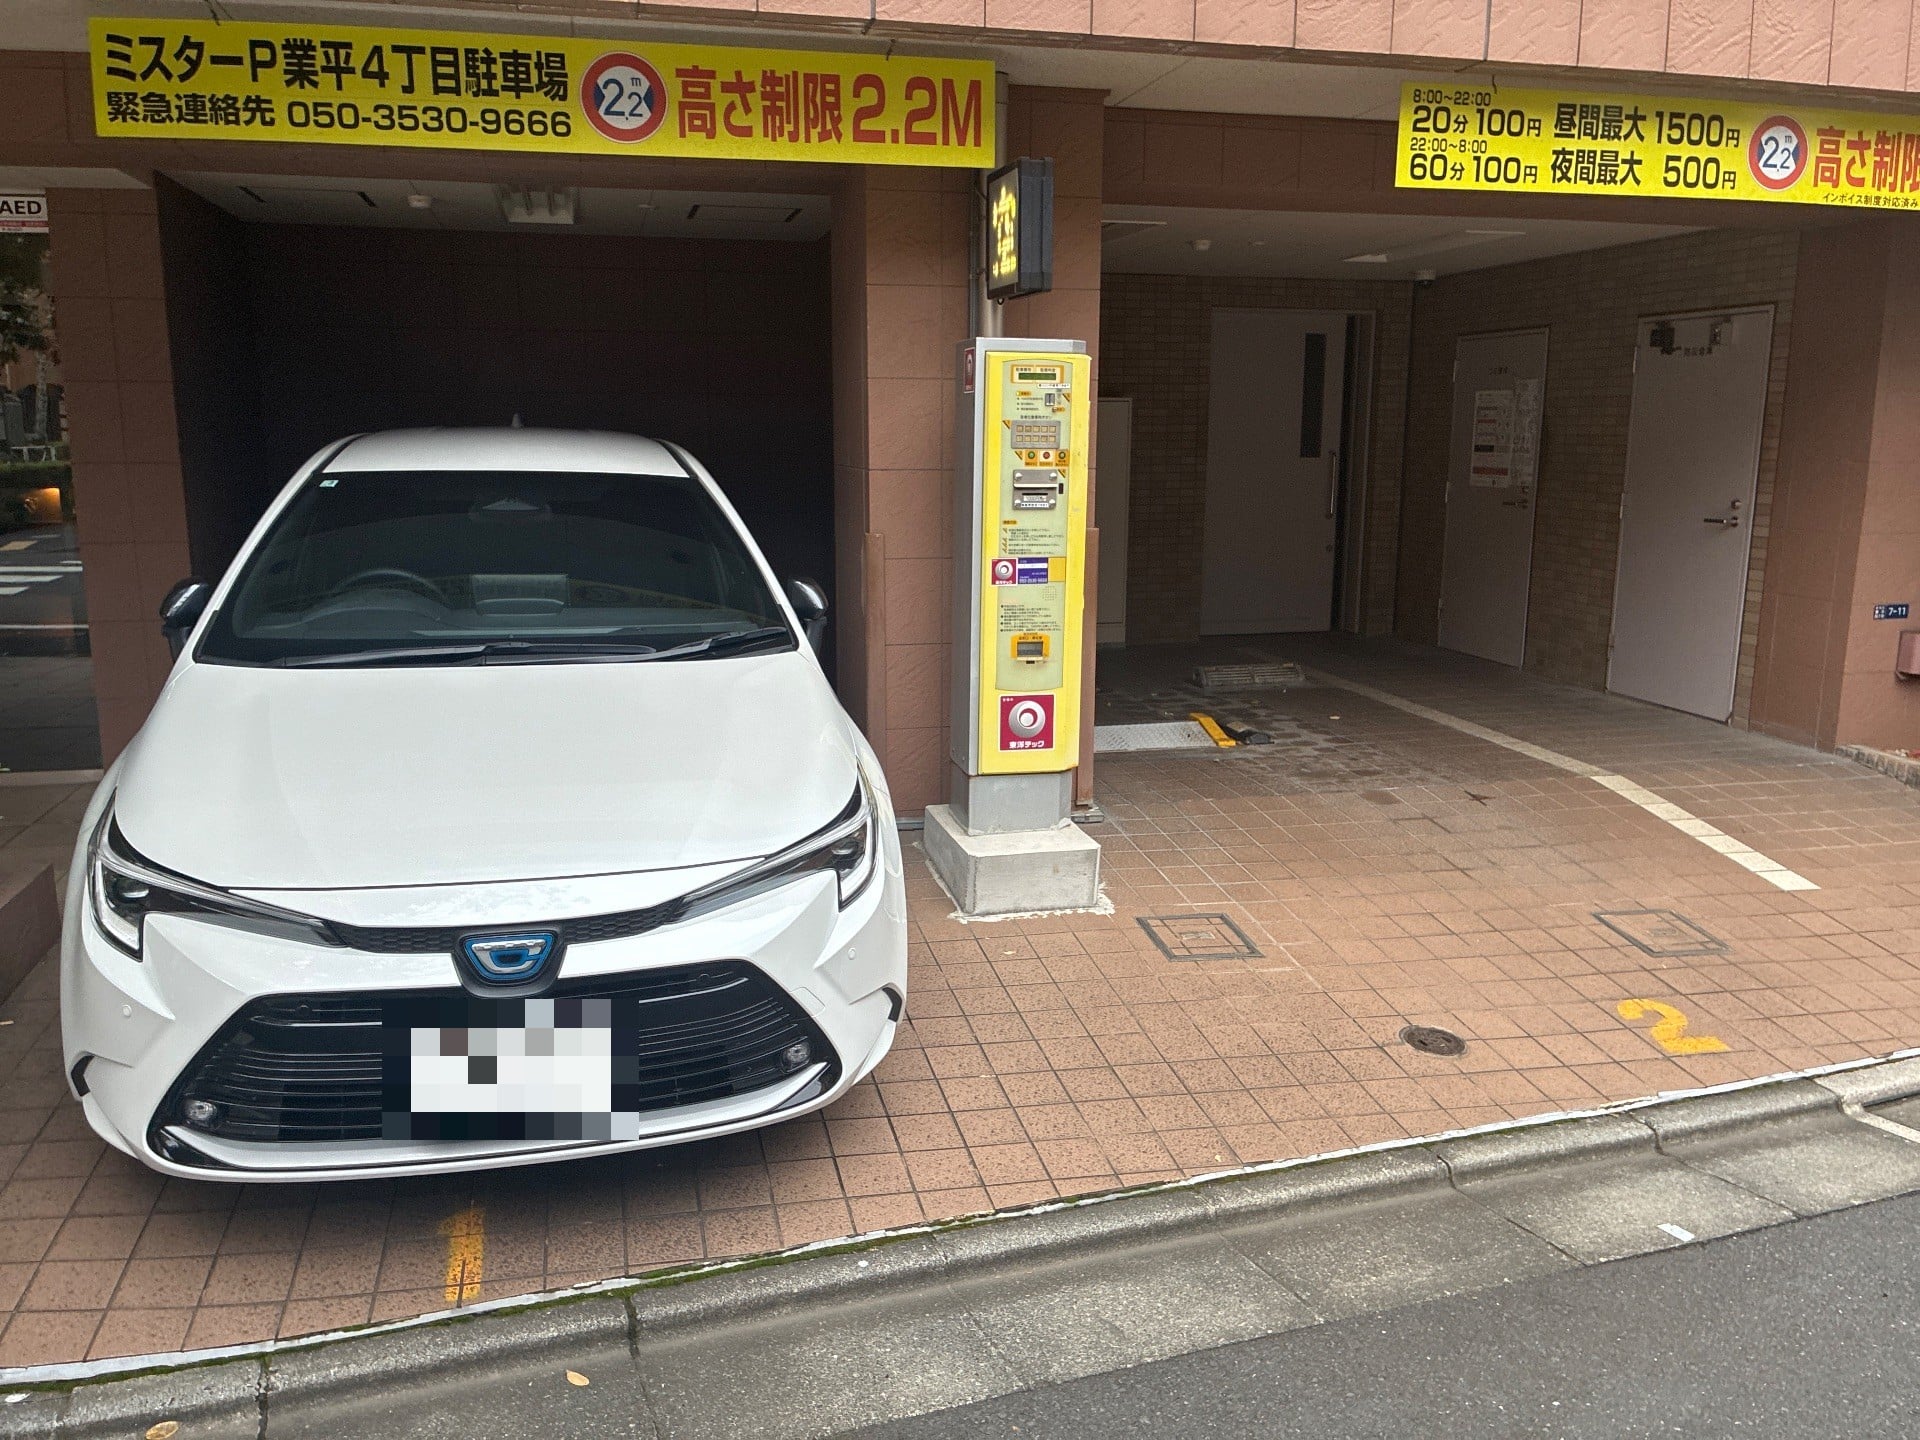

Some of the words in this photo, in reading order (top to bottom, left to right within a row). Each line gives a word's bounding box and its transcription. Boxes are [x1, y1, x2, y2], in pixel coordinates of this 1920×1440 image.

[106, 33, 568, 102] ミスターP業平4丁目駐車場
[106, 91, 276, 127] 緊急連絡先
[287, 100, 571, 138] 050-3530-9666
[1476, 108, 1542, 137] 100円
[1554, 102, 1647, 142] 昼間最大
[1655, 111, 1741, 148] 1500円
[1473, 155, 1538, 184] 100円
[1551, 147, 1643, 186] 夜間最大
[1663, 155, 1737, 189] 500円
[0, 200, 42, 215] AED
[1888, 606, 1906, 616] 7-11
[1616, 998, 1732, 1055] 2
